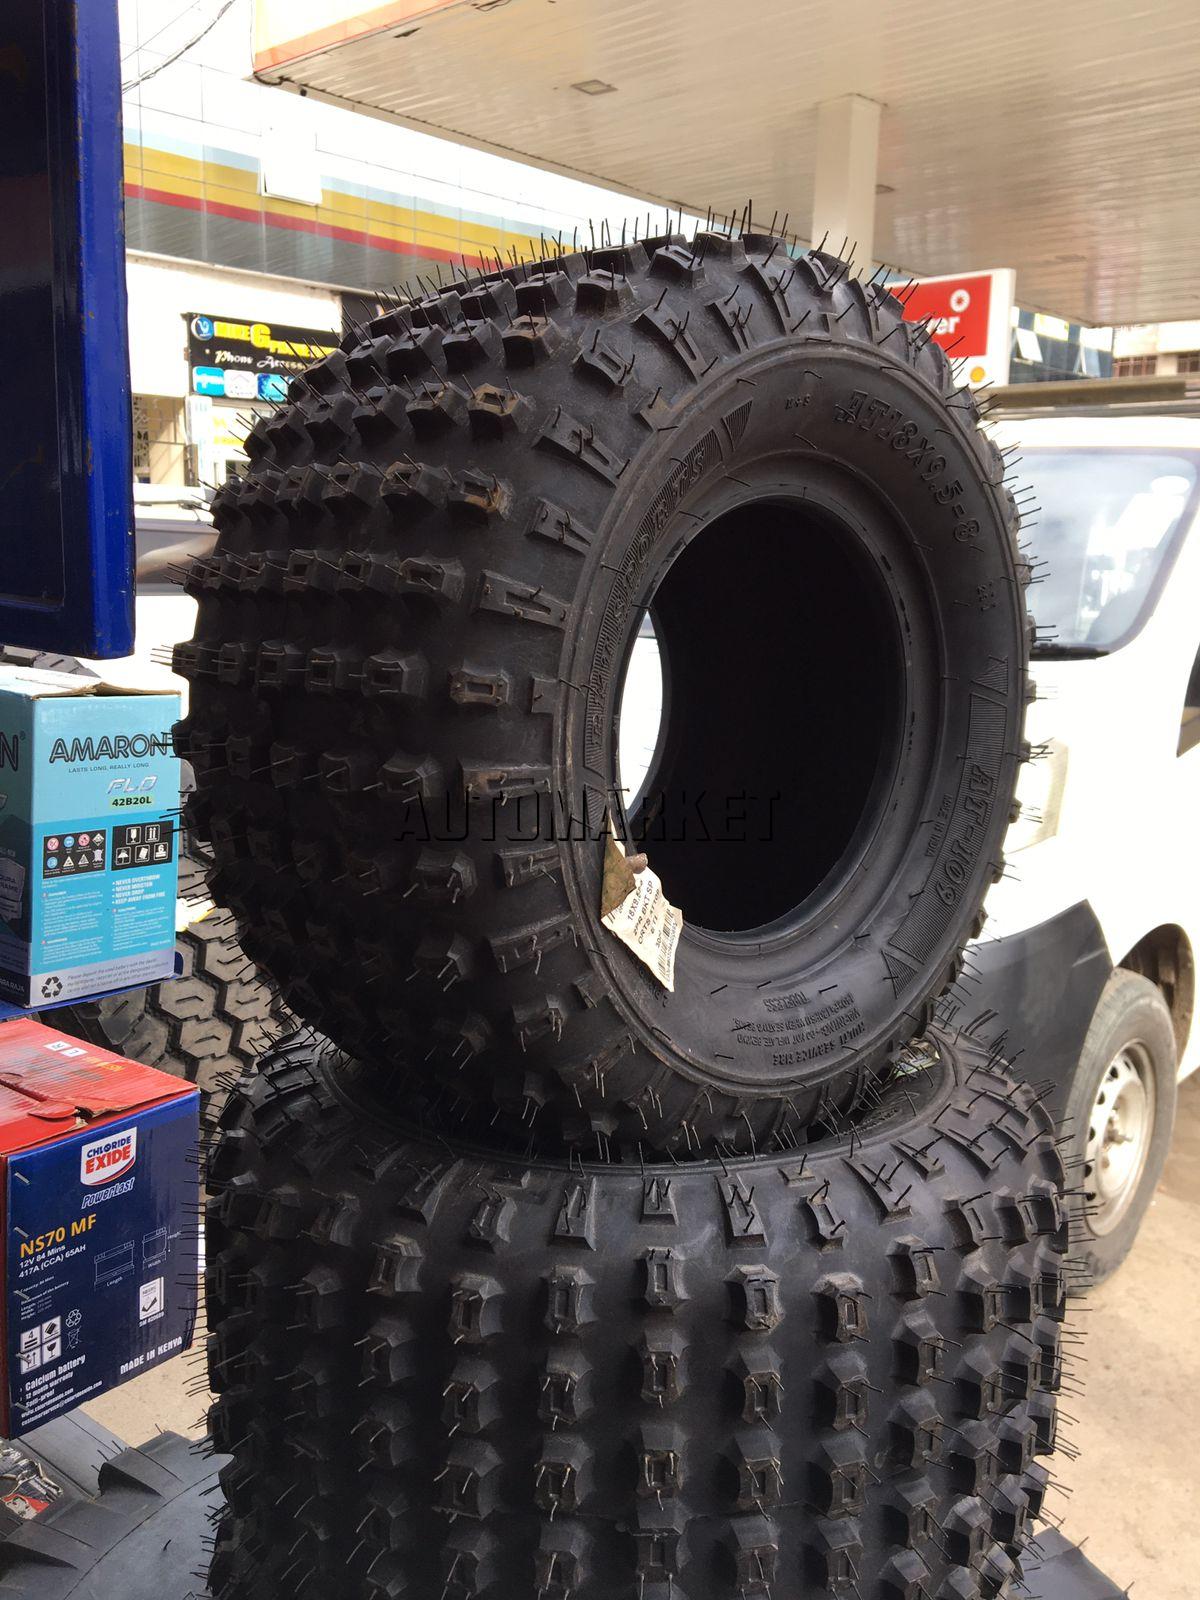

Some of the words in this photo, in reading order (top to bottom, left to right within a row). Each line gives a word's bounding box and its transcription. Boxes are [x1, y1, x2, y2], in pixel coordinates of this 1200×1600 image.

[214, 349, 253, 364] Phone
[49, 734, 167, 763] AMARON
[68, 766, 88, 774] LASTS
[112, 796, 152, 807] 42B20L
[641, 894, 651, 915] BKT
[646, 880, 653, 895] SP
[85, 1144, 131, 1174] EXIDE
[87, 1136, 131, 1158] CHLORIDE
[20, 1227, 66, 1258] NS70
[71, 1213, 97, 1236] MF
[19, 1257, 35, 1269] 12V
[36, 1253, 46, 1263] 84
[47, 1245, 66, 1257] Mins
[19, 1265, 40, 1278] 417A
[40, 1253, 64, 1270] (CCA)
[65, 1244, 86, 1258] 65AH
[120, 1356, 145, 1375] MADE
[146, 1351, 156, 1361] IN
[157, 1336, 183, 1353] KENYA
[25, 1369, 56, 1391] Calcium
[57, 1354, 86, 1375] battery
[49, 1371, 74, 1388] warranty
